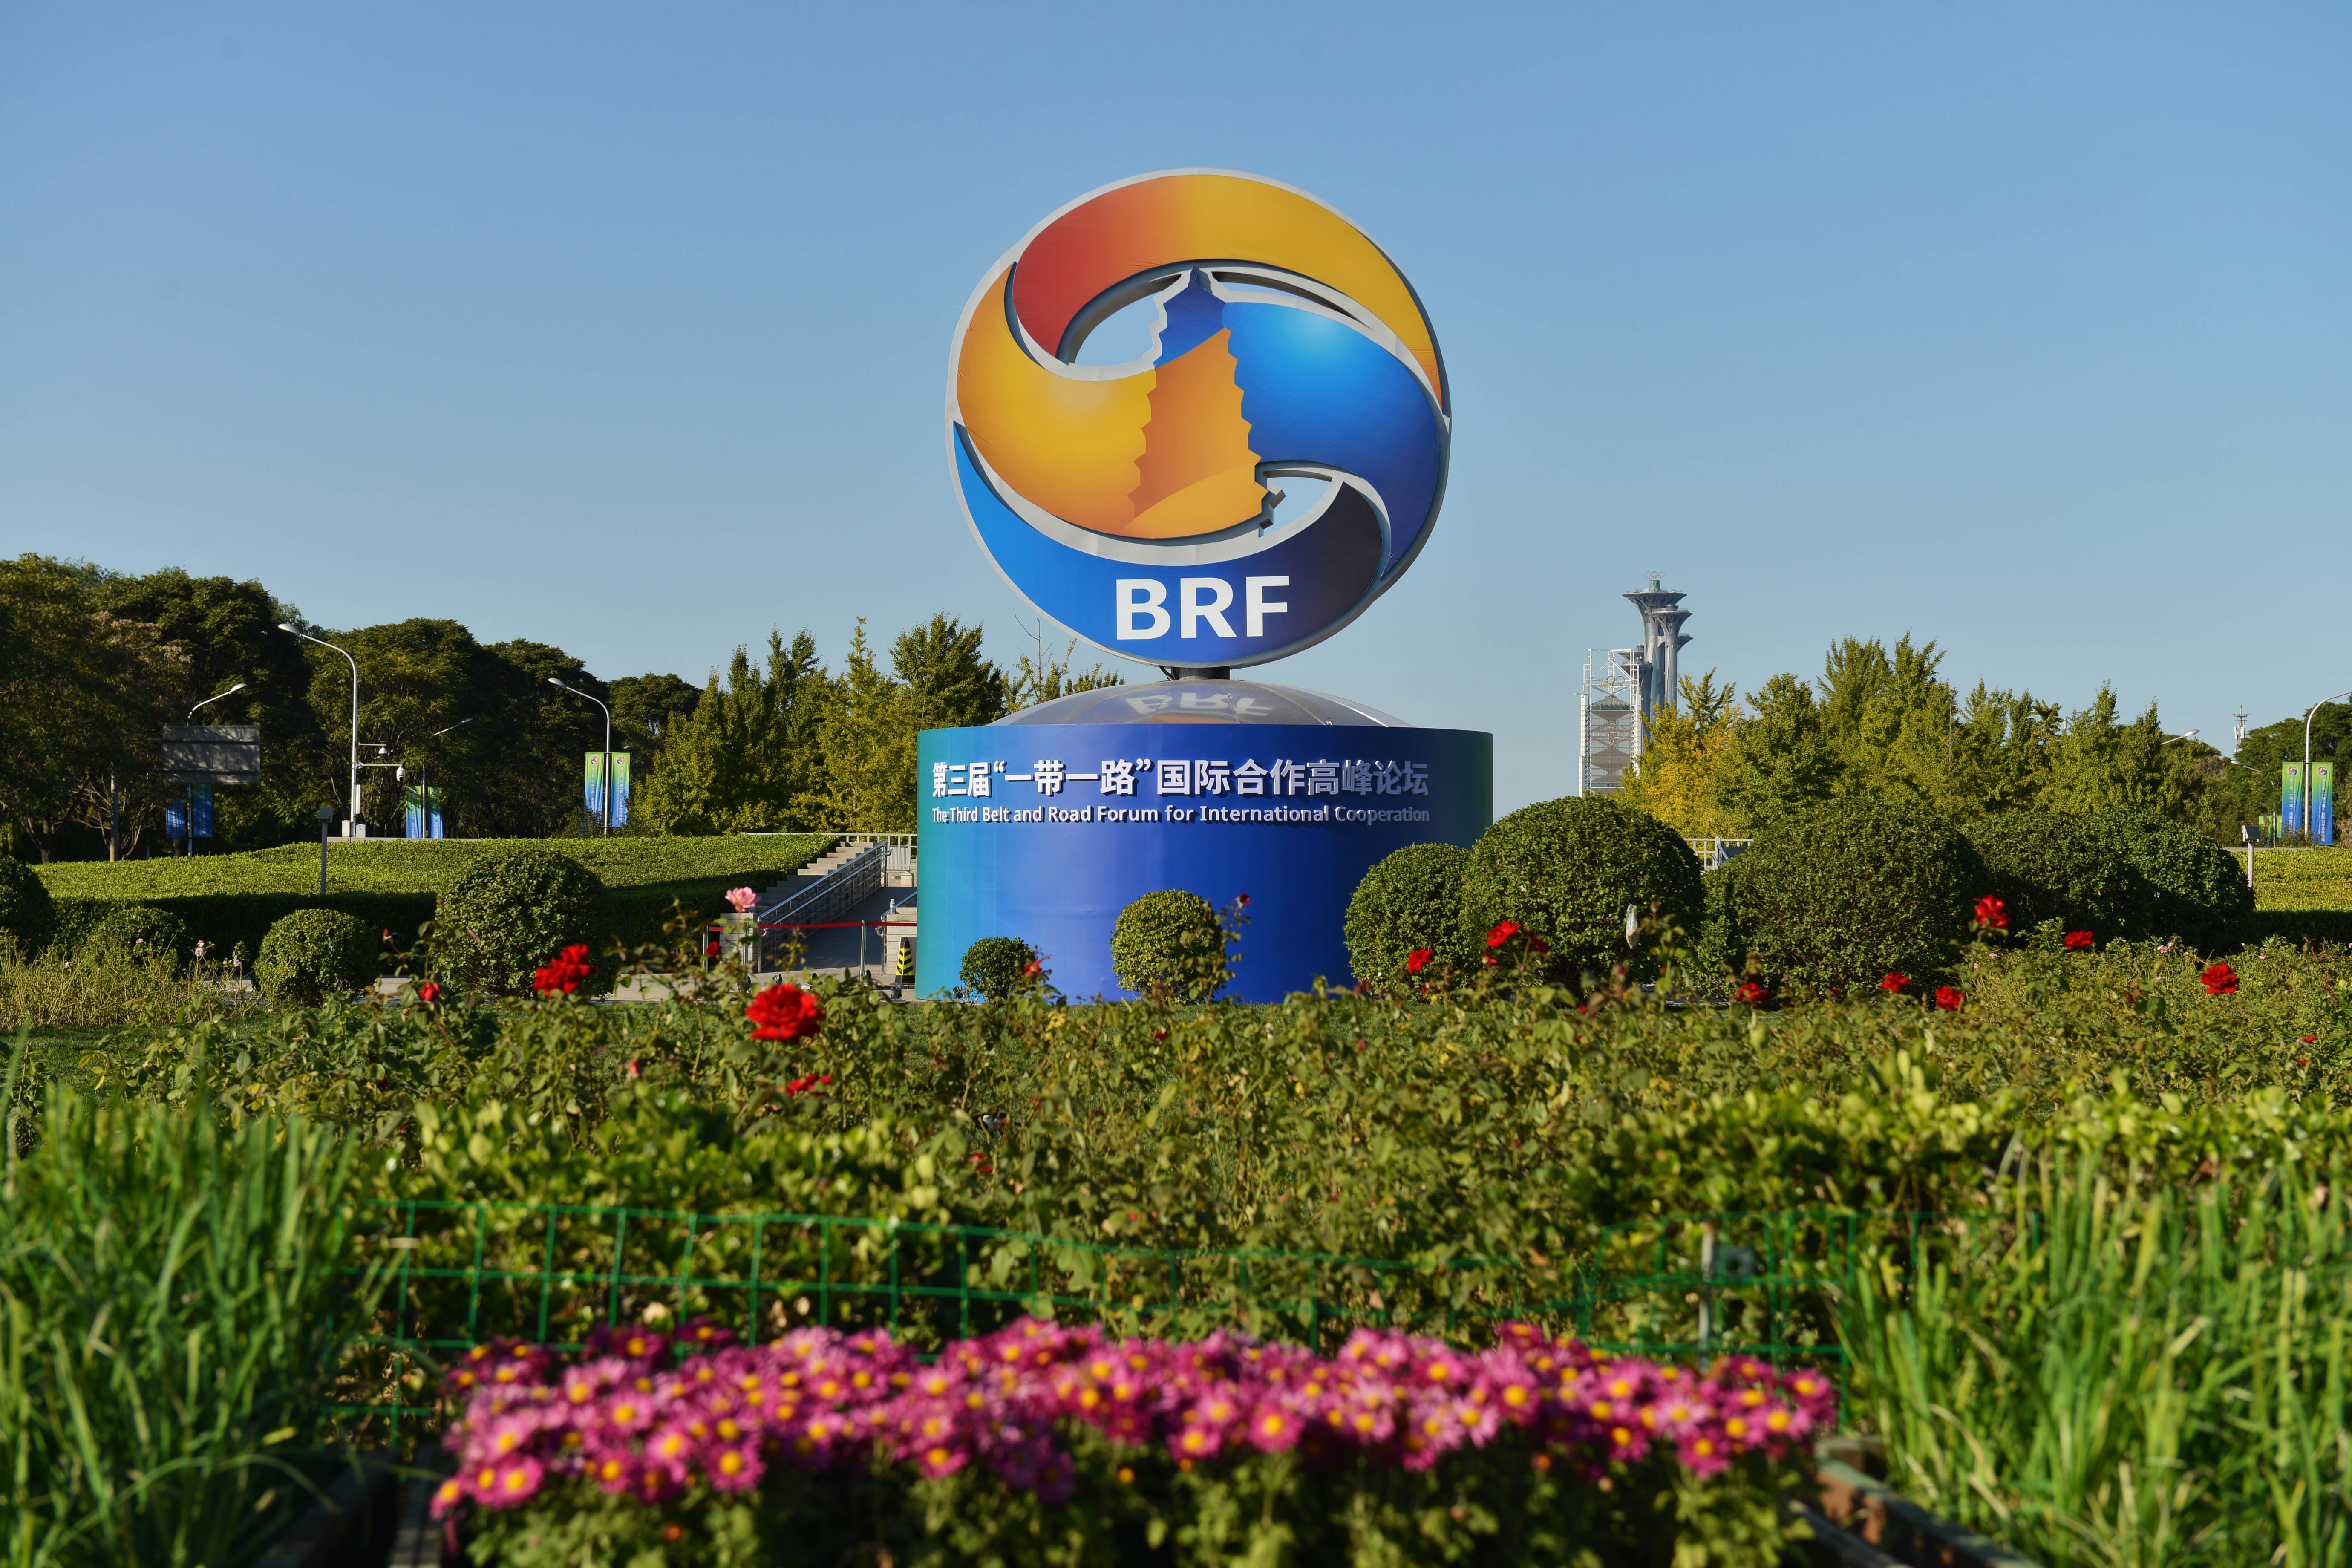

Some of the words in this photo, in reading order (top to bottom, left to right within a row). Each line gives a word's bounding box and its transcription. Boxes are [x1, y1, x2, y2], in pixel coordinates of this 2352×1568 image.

[1116, 576, 1289, 640] BRF
[932, 758, 1429, 798] 第三届“一带一路”国际合作高峰论坛
[932, 808, 949, 823] The
[949, 806, 978, 822] Third
[983, 806, 1009, 822] Belt
[1013, 805, 1043, 822] and
[1048, 805, 1091, 822] Road
[1097, 806, 1159, 821] Forum
[1166, 805, 1194, 821] for
[1199, 806, 1329, 821] International
[1335, 806, 1430, 826] Cooperation
